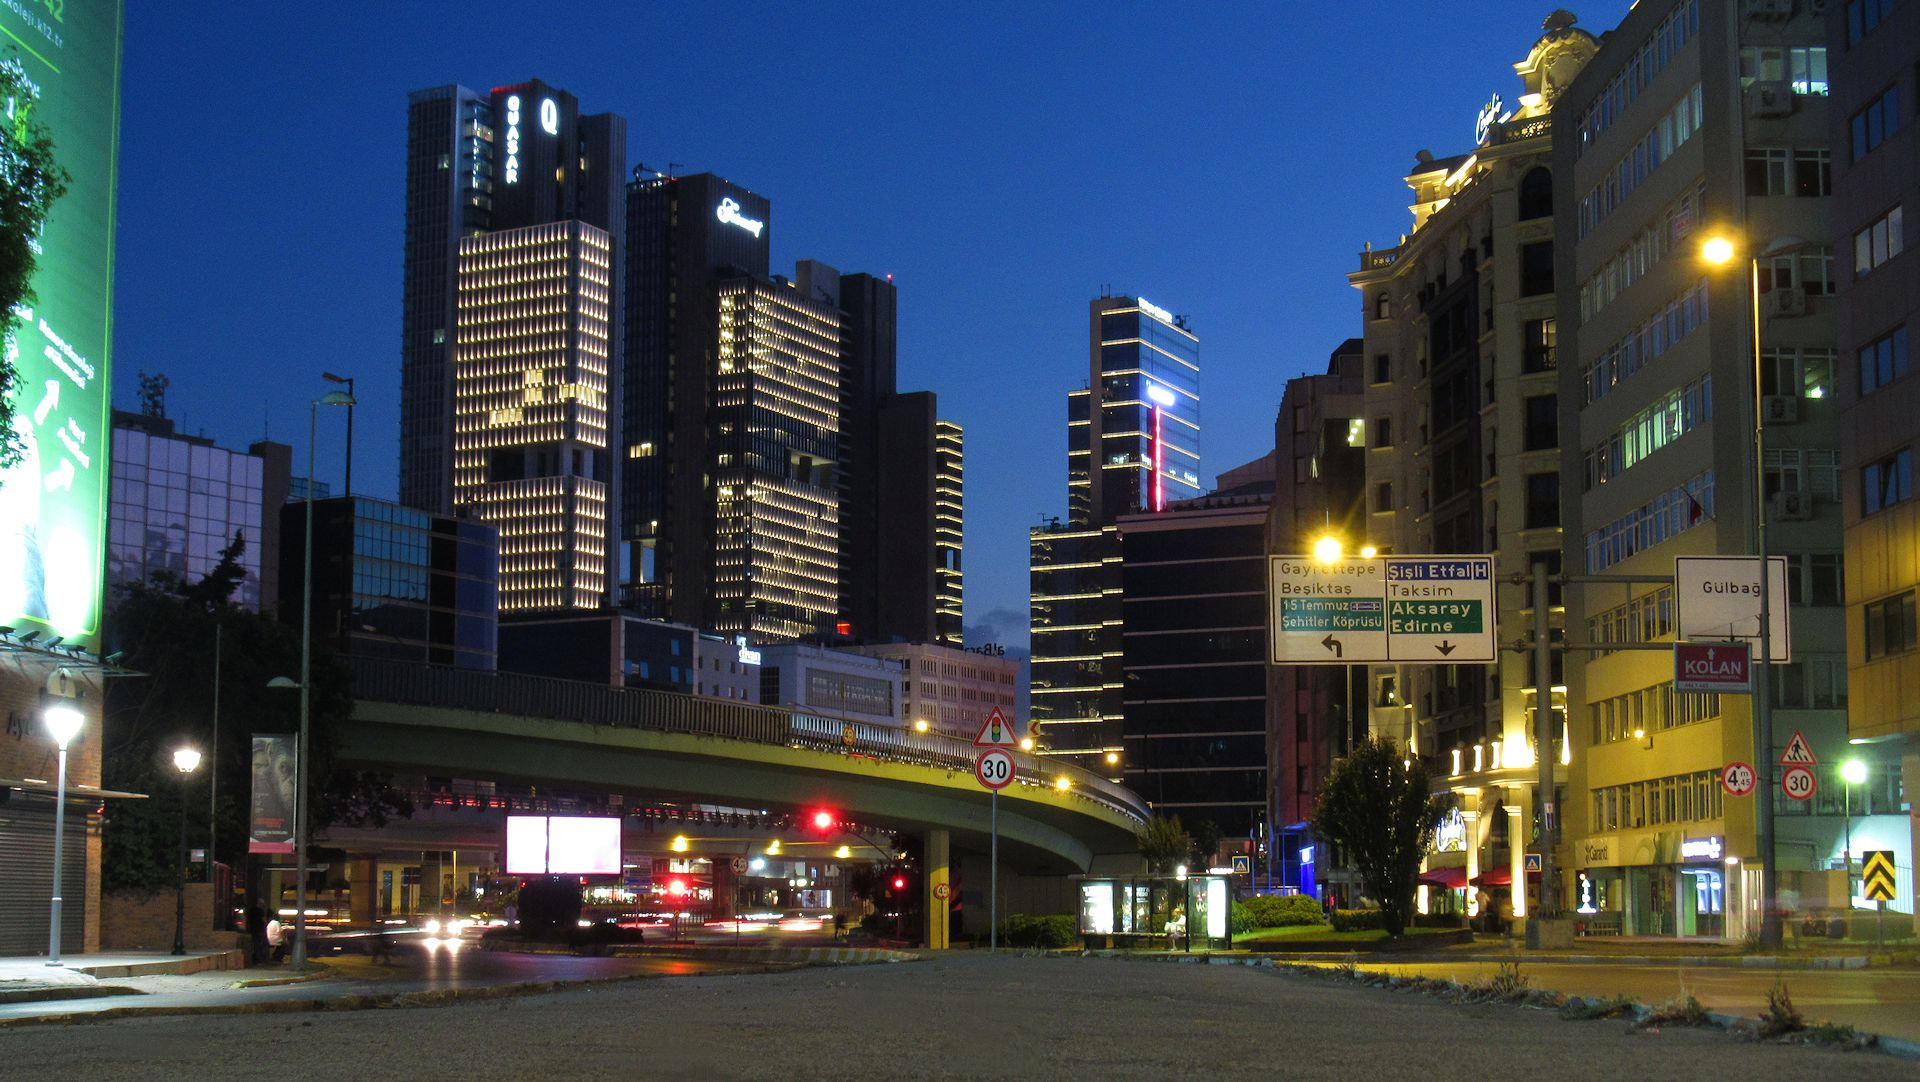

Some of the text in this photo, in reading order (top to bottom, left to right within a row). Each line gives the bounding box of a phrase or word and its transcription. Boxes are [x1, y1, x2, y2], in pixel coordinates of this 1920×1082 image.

[541, 98, 557, 136] Q
[506, 95, 520, 184] QUASAR
[1389, 565, 1423, 580] Şişli
[1429, 564, 1470, 578] Etfal
[1281, 583, 1352, 595] Beşiktaş
[1390, 584, 1453, 597] Taksim
[1284, 600, 1349, 611] 15 Temmuz
[1392, 602, 1471, 617] Aksaray
[1282, 615, 1382, 629] Şehitler Köprüsü
[1392, 619, 1453, 633] Edirne
[1685, 660, 1741, 674] KOLAN
[983, 759, 1007, 779] 30
[1789, 775, 1809, 792] 30
